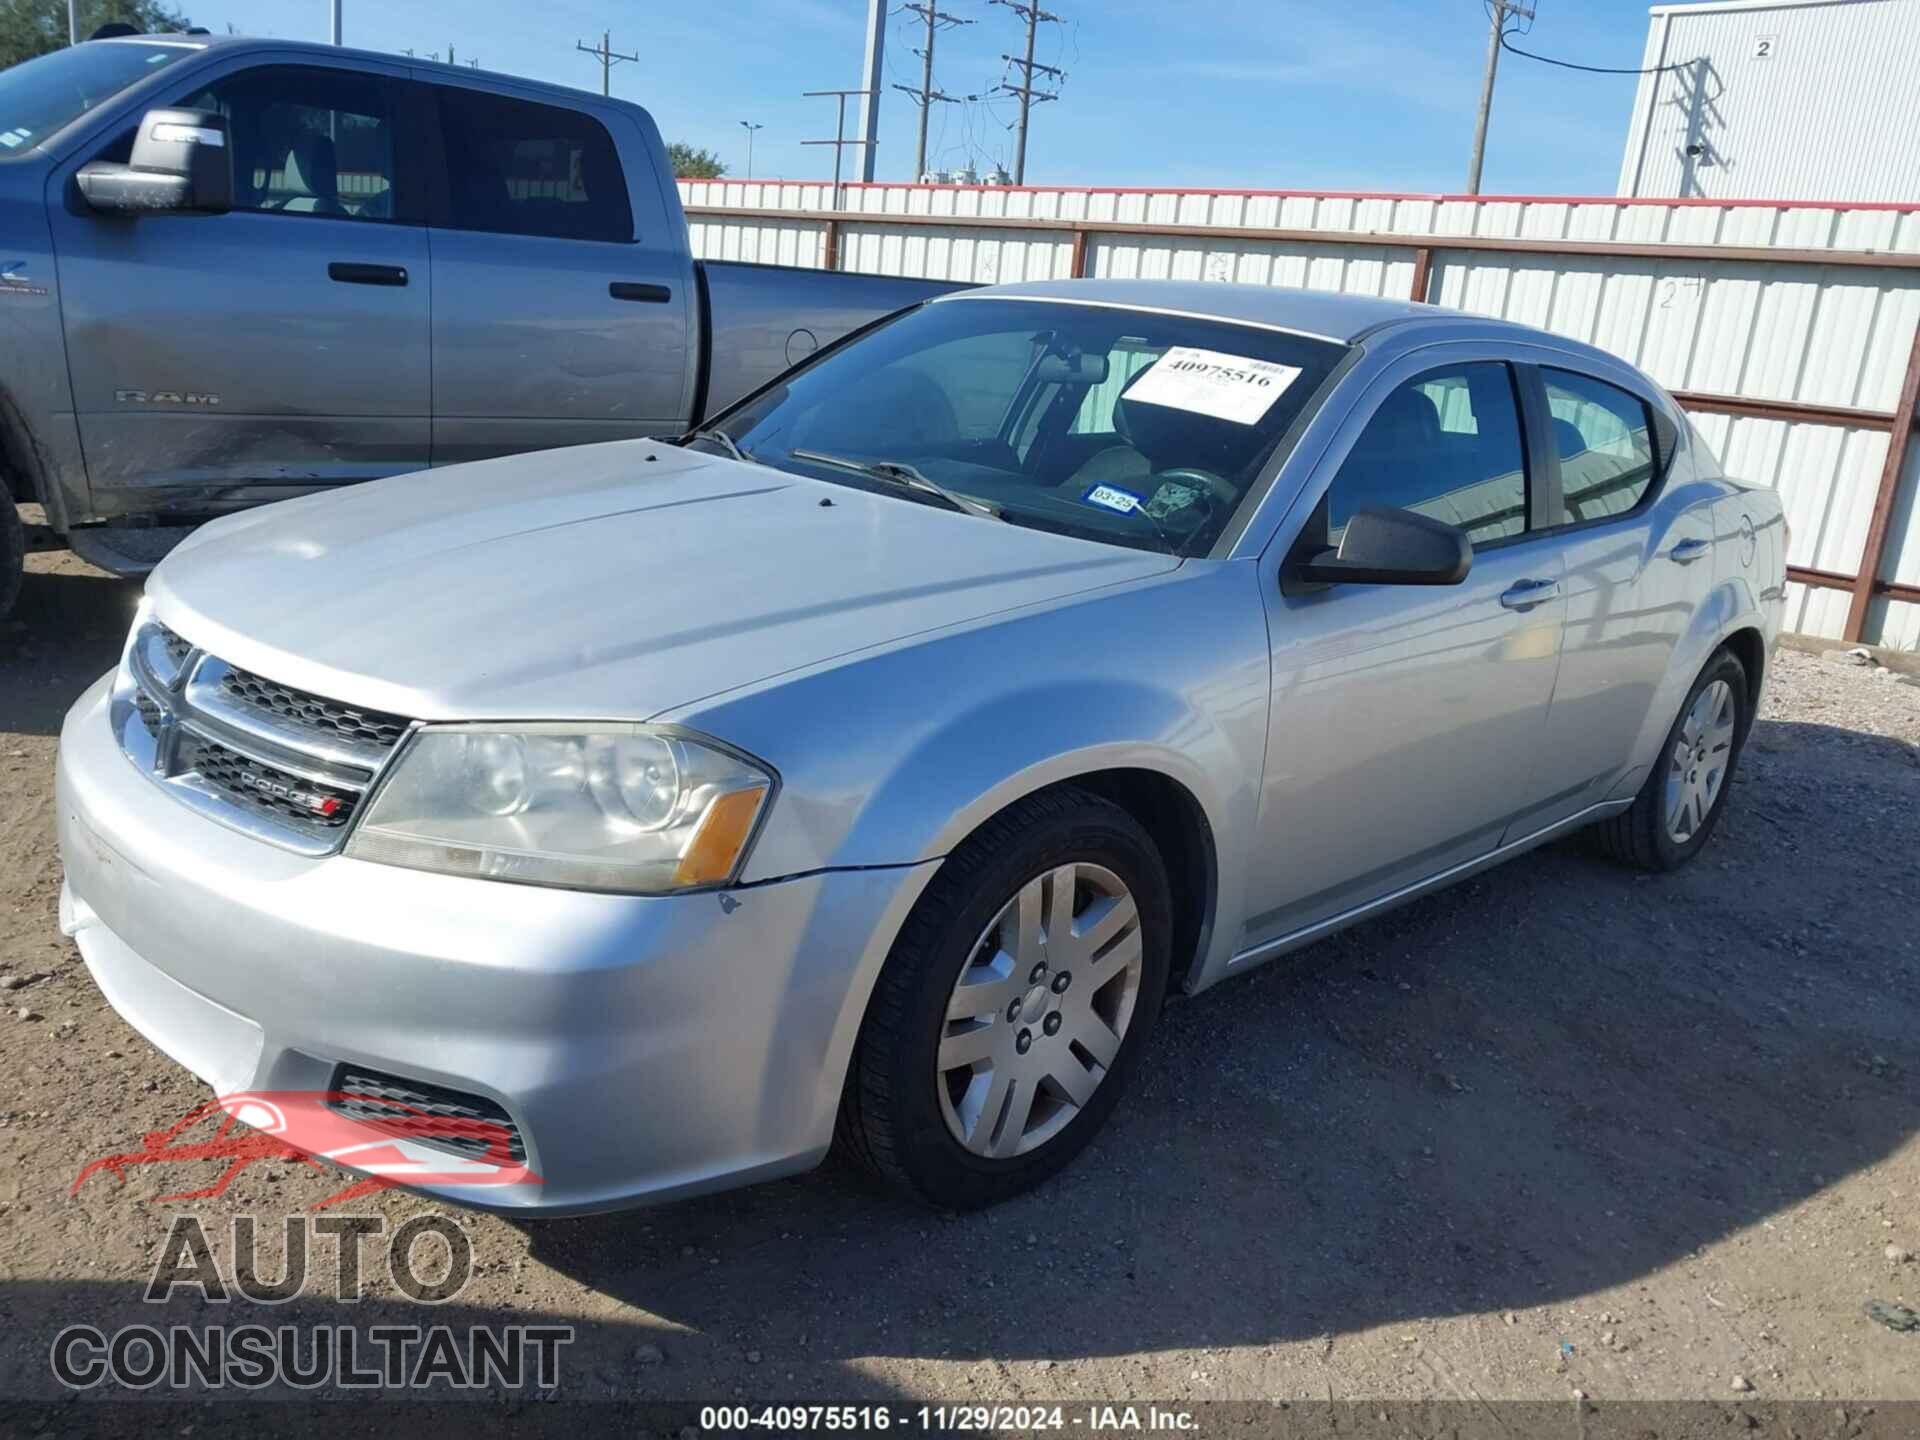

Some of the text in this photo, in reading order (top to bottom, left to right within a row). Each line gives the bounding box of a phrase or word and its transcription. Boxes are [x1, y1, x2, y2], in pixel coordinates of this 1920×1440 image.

[1756, 41, 1771, 57] 2
[1167, 359, 1273, 388] 40975516
[113, 389, 221, 404] RAM
[241, 771, 323, 808] DODGE
